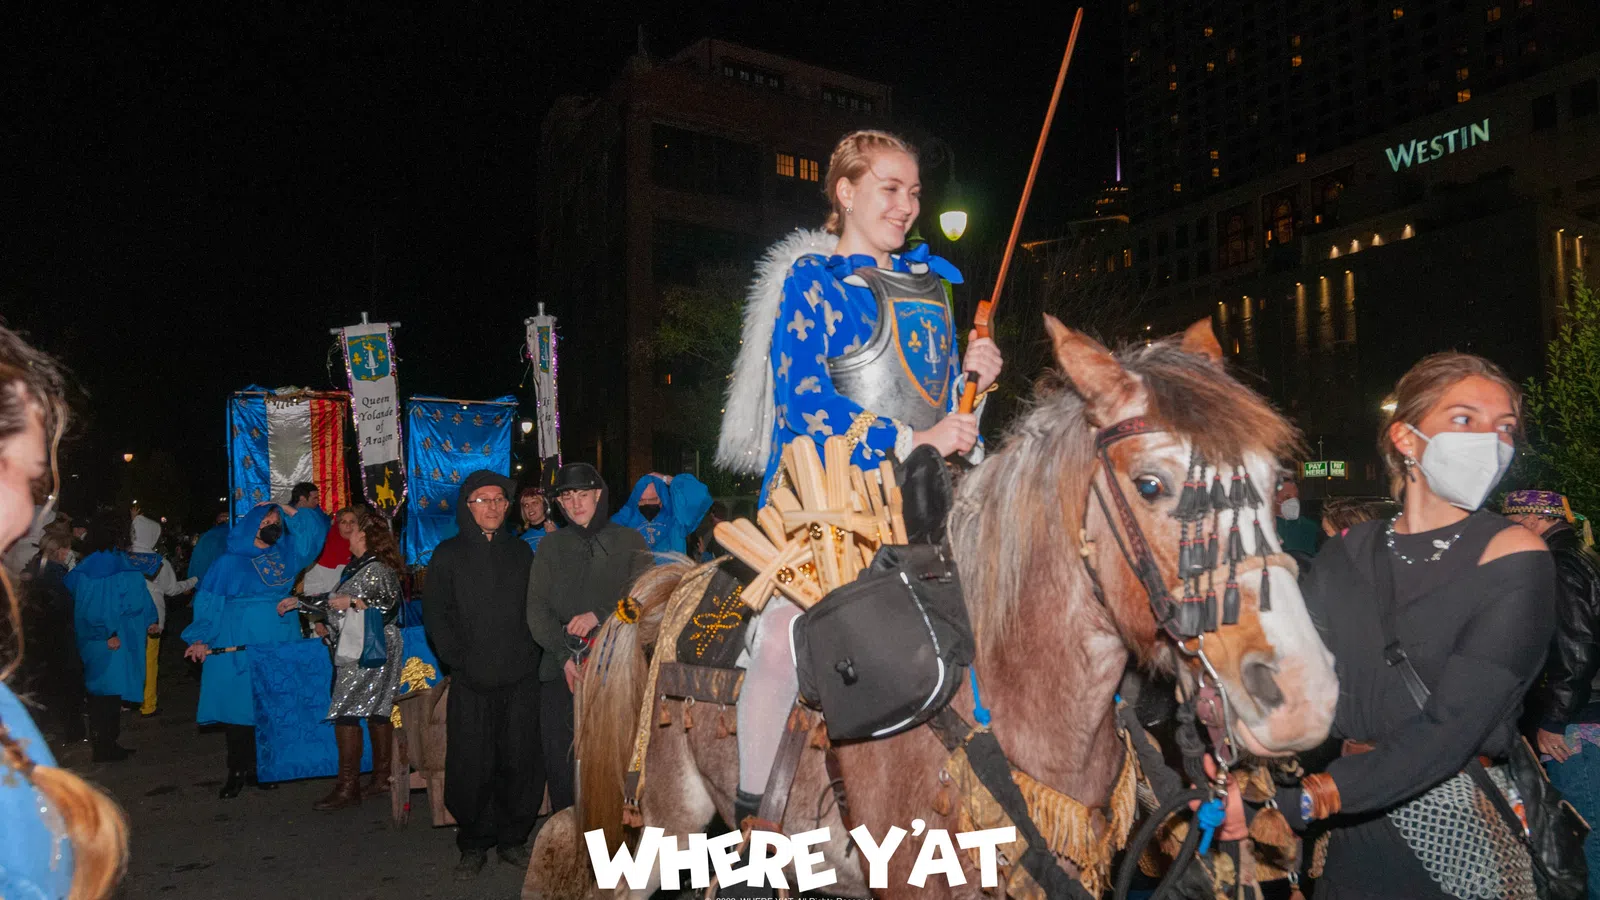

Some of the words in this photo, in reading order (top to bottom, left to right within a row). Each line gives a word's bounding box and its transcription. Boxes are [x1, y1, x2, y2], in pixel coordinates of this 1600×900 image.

[1385, 118, 1490, 173] WESTIN
[361, 395, 390, 408] Queen
[359, 406, 394, 421] Yolande
[375, 419, 385, 434] of
